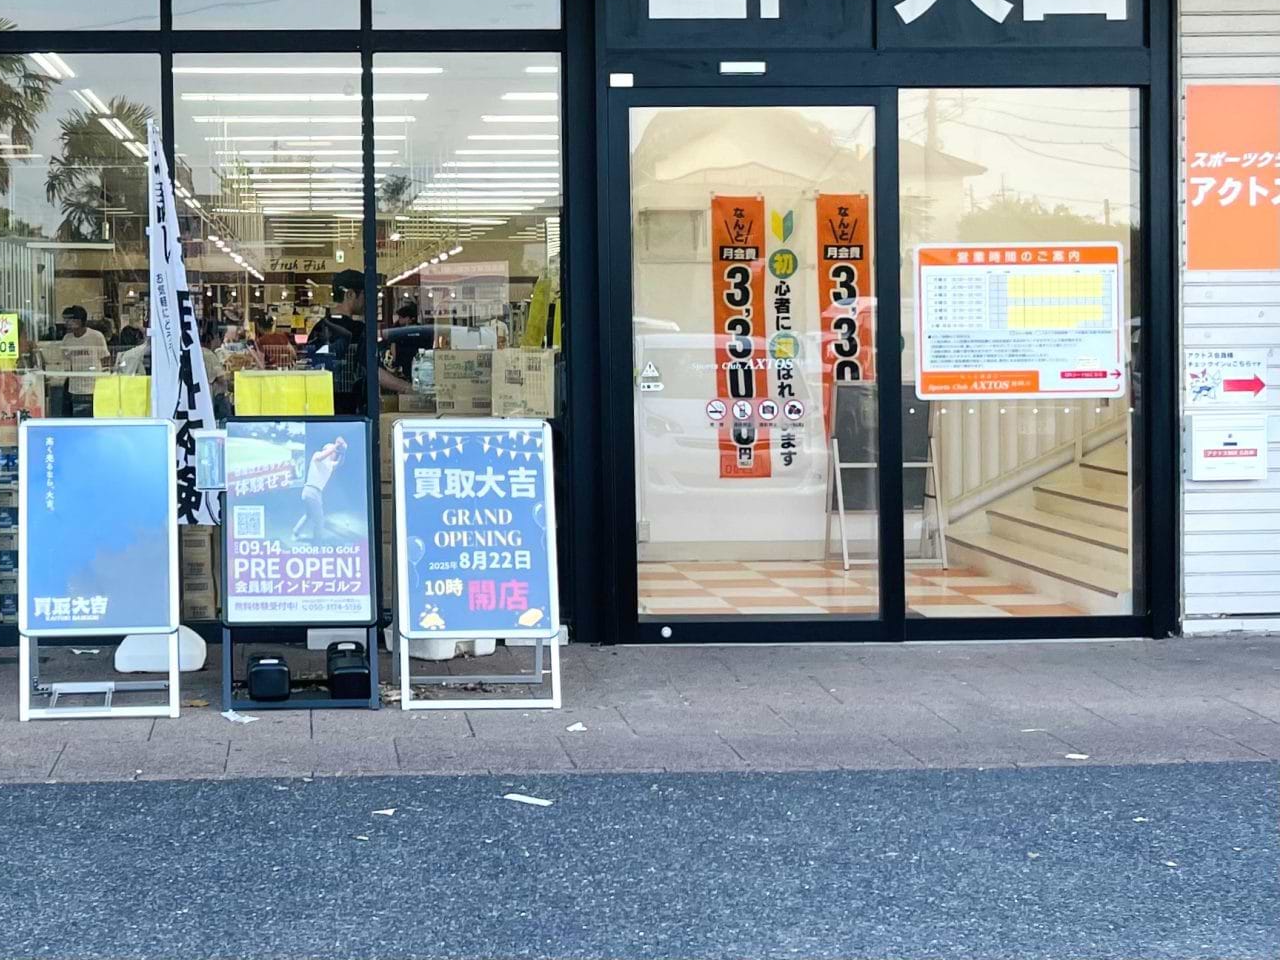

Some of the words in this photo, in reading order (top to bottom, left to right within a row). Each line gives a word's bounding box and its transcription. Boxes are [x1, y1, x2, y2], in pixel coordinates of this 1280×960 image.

[731, 207, 745, 243] なんと
[836, 206, 849, 241] なんと
[722, 247, 757, 260] 月会費
[827, 246, 863, 259] 月会費
[956, 250, 1082, 264] 営業時間のご案内
[743, 358, 795, 370] AXTOS
[971, 380, 1010, 390] AXTOS
[235, 470, 296, 497] 体験せよ
[413, 466, 538, 499] 買取大吉
[442, 508, 513, 526] GRAND
[239, 540, 282, 556] 09.14
[292, 546, 320, 554] DOOR
[322, 546, 333, 554] TO
[336, 546, 361, 554] GOLF
[433, 530, 523, 548] OPENING
[234, 558, 281, 579] PRE
[285, 557, 362, 579] OPEN!
[428, 561, 457, 571] 2025年
[459, 550, 531, 571] 8月22日
[235, 580, 362, 594] 会員制インドアゴルフ
[424, 577, 463, 597] 10時
[468, 578, 530, 611] 開店
[34, 595, 108, 616] 買取大吉
